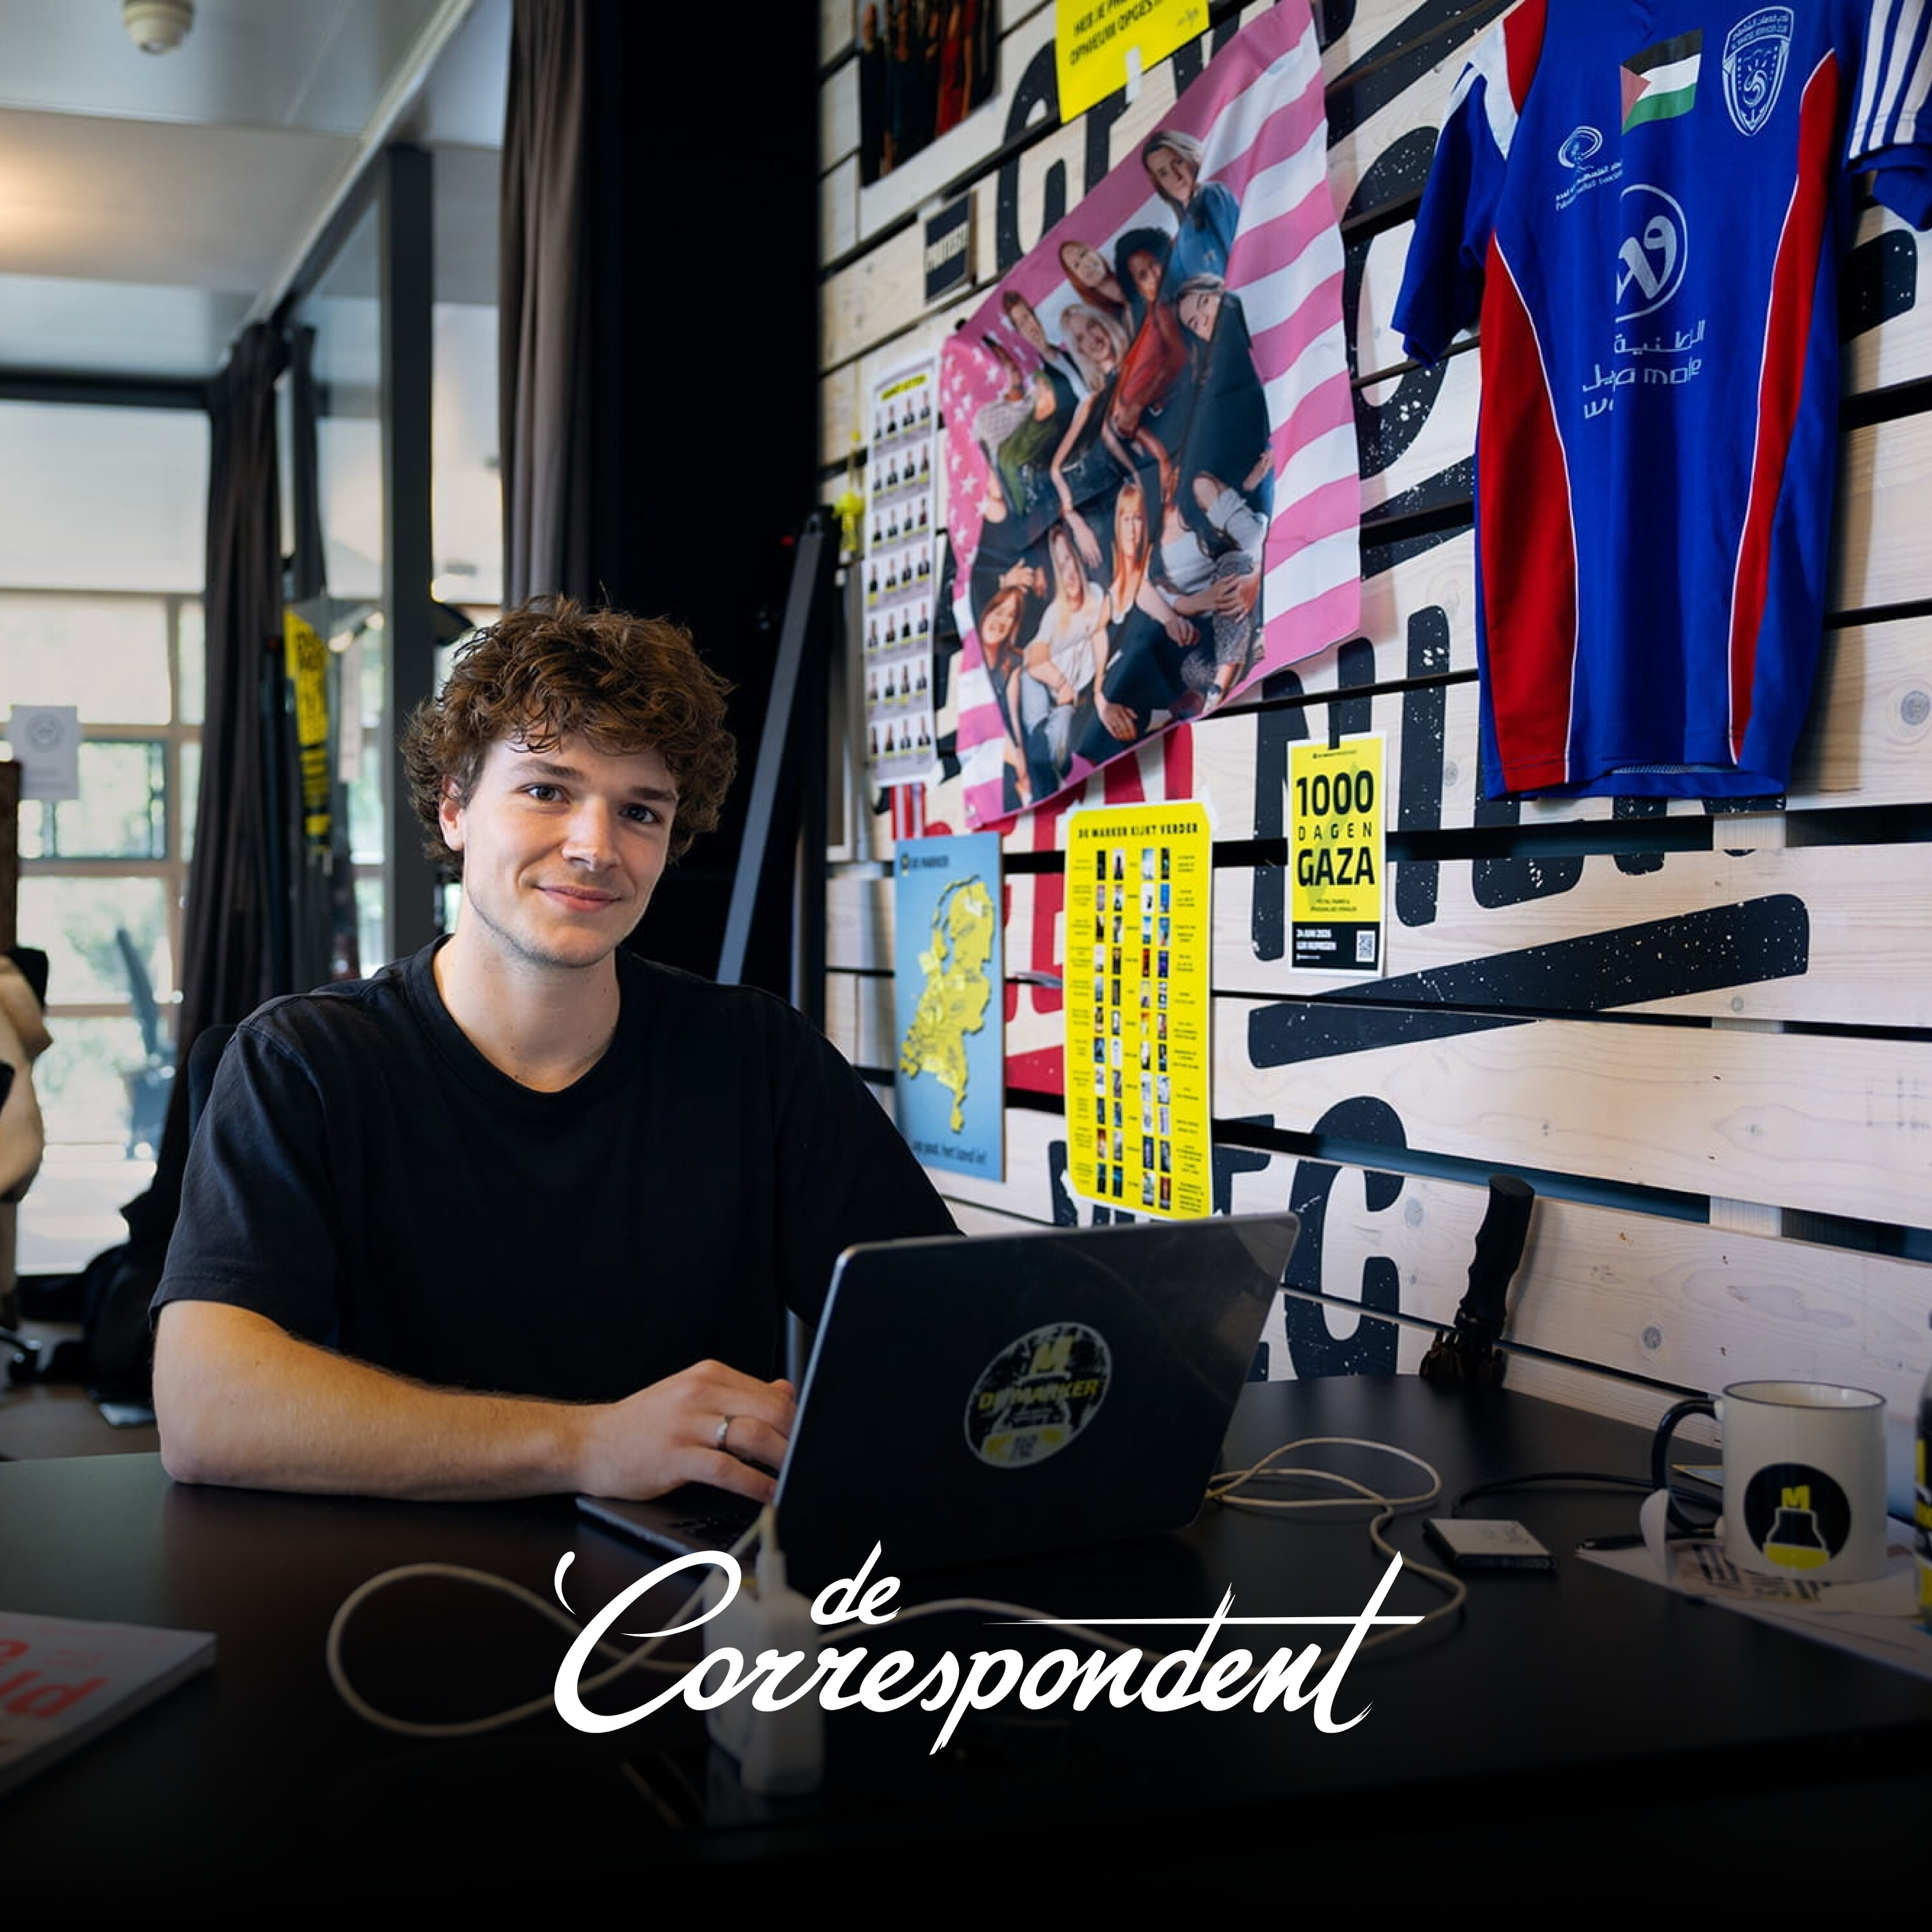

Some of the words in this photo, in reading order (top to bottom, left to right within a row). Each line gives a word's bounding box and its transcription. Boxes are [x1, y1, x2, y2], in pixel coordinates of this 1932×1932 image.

[1296, 770, 1374, 817] 1000
[1160, 822, 1198, 835] VERDER
[1298, 822, 1372, 842] DAGEN
[1298, 847, 1376, 887] GAZA
[1010, 1379, 1100, 1406] MARKER
[1781, 1485, 1811, 1511] M
